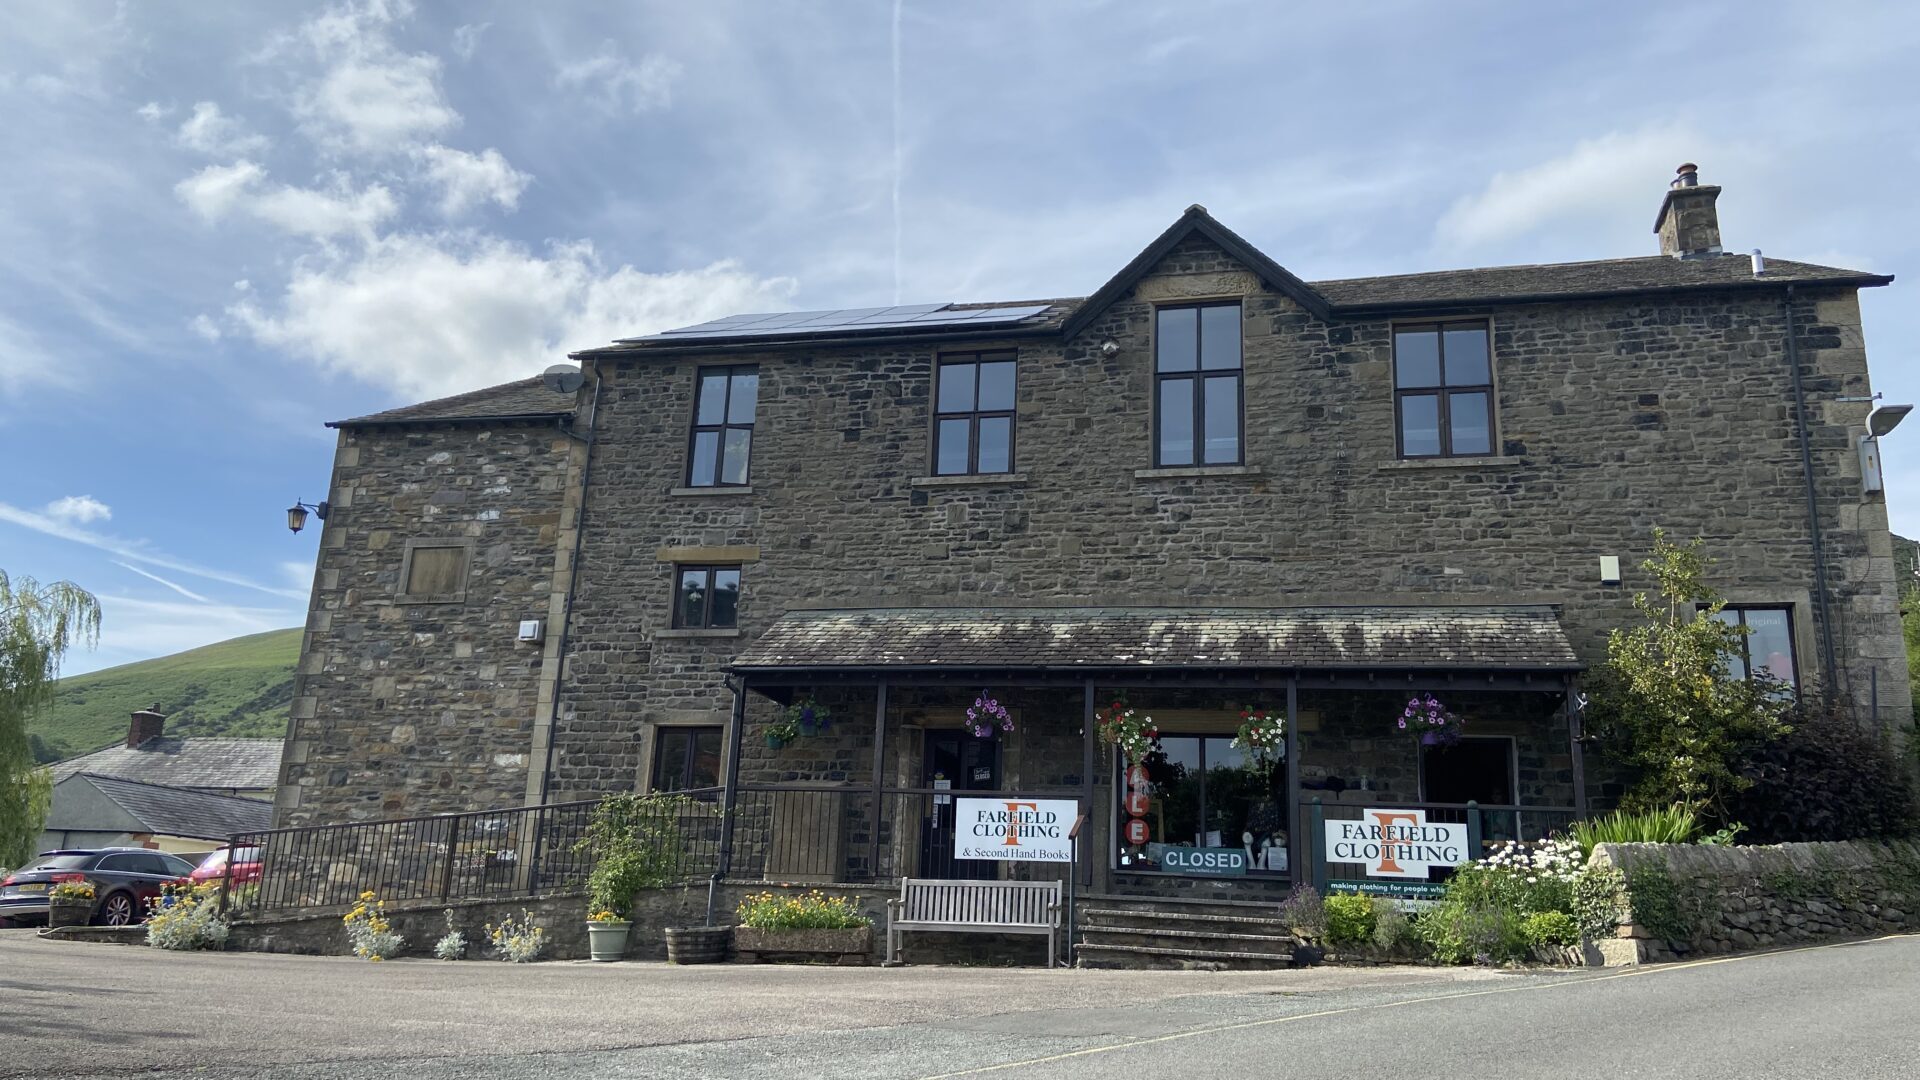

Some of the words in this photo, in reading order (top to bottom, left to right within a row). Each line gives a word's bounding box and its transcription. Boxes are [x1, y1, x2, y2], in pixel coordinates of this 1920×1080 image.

[977, 810, 1056, 824] FARFIELD
[973, 824, 1060, 838] CLOTHING
[1341, 823, 1450, 842] FARFIELD
[963, 847, 971, 857] &
[975, 848, 1008, 858] Second
[1011, 849, 1036, 858] Hand
[1039, 849, 1069, 860] Books
[1165, 851, 1242, 868] CLOSED
[1334, 843, 1459, 862] CLOTHING
[1330, 882, 1357, 891] making
[1360, 882, 1388, 892] clothing
[1404, 885, 1428, 893] people
